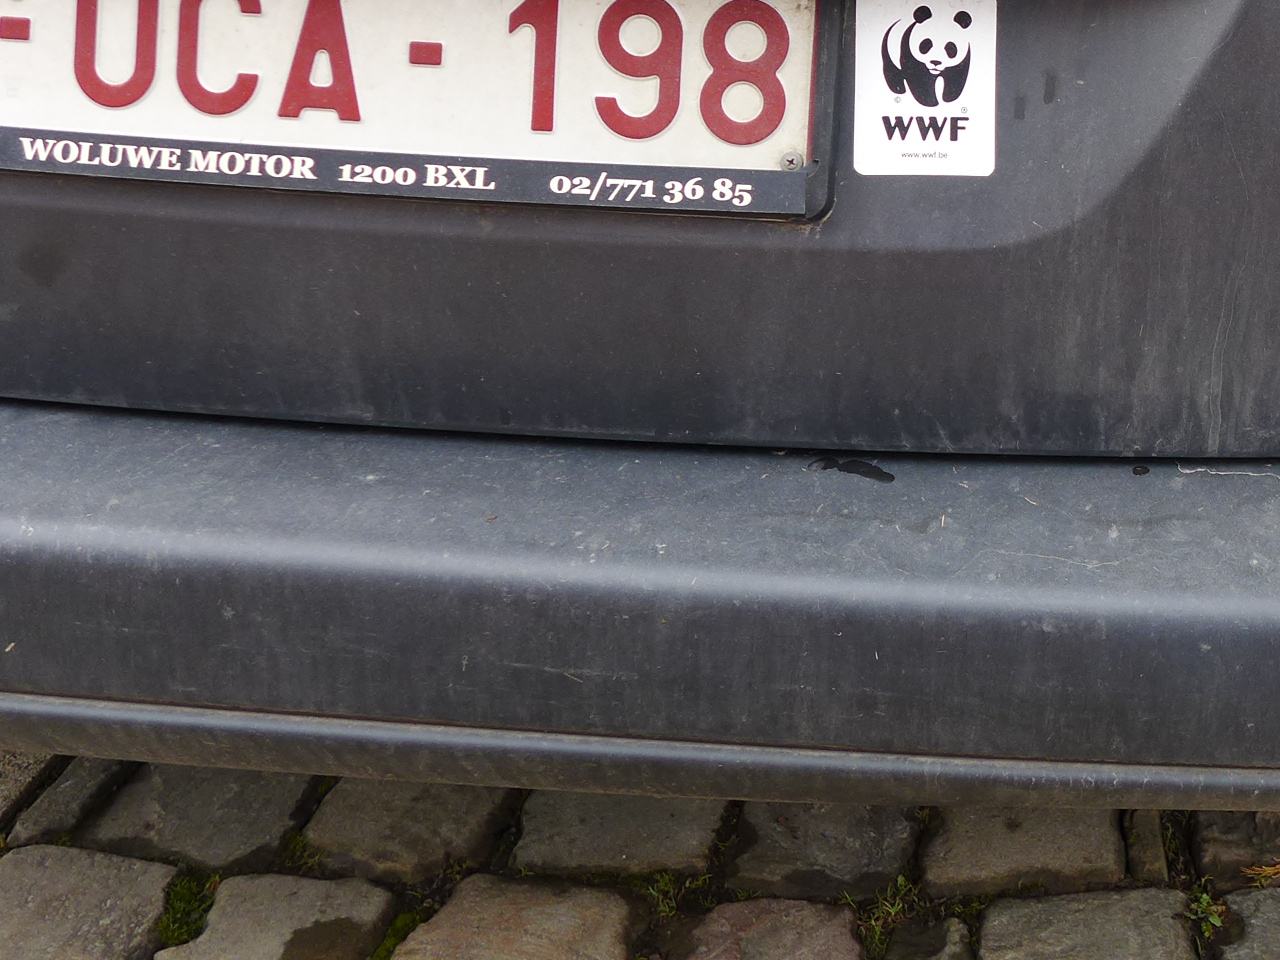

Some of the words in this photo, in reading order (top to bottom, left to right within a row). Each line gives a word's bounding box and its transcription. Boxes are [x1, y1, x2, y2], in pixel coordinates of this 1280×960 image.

[882, 116, 969, 142] WWF
[901, 150, 948, 159] www.wwf.be
[19, 137, 182, 172] WOLUWE
[186, 149, 318, 180] MOTOR
[337, 163, 417, 186] 1200
[423, 164, 496, 191] BXL
[549, 171, 657, 202] 02/771
[662, 177, 705, 204] 36
[712, 177, 754, 207] 85
